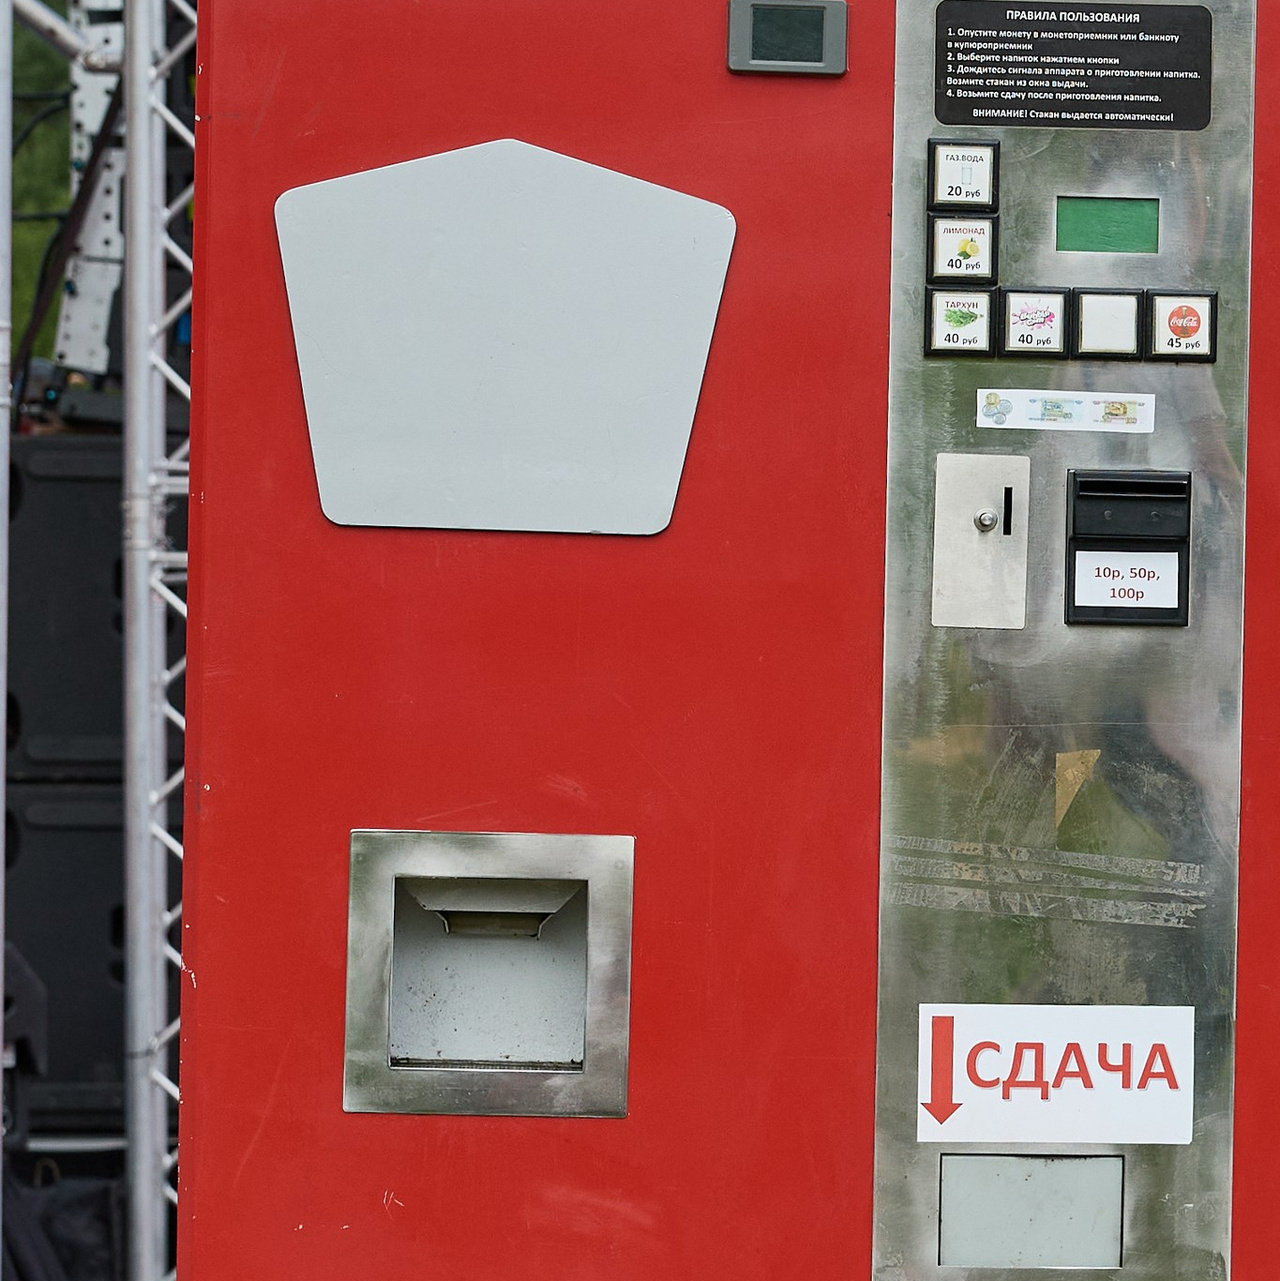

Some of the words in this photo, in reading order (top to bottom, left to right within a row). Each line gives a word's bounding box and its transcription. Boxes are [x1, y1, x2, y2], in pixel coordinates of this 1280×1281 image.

[1006, 10, 1057, 21] ПРАВИЛА
[1060, 11, 1140, 23] ПОЛЬЗОВАНИЯ
[947, 27, 956, 37] 1.
[957, 28, 998, 39] Опустите
[998, 31, 1032, 40] монету
[1040, 32, 1119, 41] монетоприемник
[1138, 32, 1180, 43] банкноту
[954, 42, 1033, 51] купюроприемник
[946, 52, 955, 61] 2.
[957, 52, 1001, 63] Выберите
[1002, 54, 1039, 63] напиток
[1040, 56, 1086, 64] нажатием
[1086, 56, 1120, 65] кнопки
[946, 65, 955, 73] 3.
[956, 64, 1007, 75] Дождитесь
[1008, 67, 1043, 75] сигнала
[1044, 68, 1085, 77] аппарата
[1094, 69, 1161, 78] приготовлении
[1163, 70, 1201, 79] напитка.
[946, 76, 985, 86] Возмите
[1051, 81, 1089, 89] выдачи.
[946, 89, 955, 97] 4.
[956, 89, 999, 99] Возьмите
[1000, 91, 1027, 101] сдачу
[1055, 92, 1122, 101] приготовления
[1123, 93, 1162, 102] напитка.
[972, 108, 1028, 118] ВНИМАНИЕ!
[1029, 109, 1060, 118] Стакан
[1061, 111, 1103, 120] выдается
[1104, 112, 1174, 121] автоматически!
[945, 154, 984, 163] ГАЗ.ВОДА
[947, 185, 962, 196] 20
[965, 189, 981, 199] руб
[942, 227, 986, 236] ЛИМОНАД
[947, 258, 962, 269] 40
[965, 261, 981, 271] руб
[945, 301, 979, 309] ТАРХУН
[944, 333, 960, 344] 40
[962, 336, 978, 345] руб
[1018, 334, 1033, 344] 40
[1036, 336, 1052, 346] руб
[1167, 337, 1182, 348] 45
[1185, 340, 1201, 350] руб
[1094, 566, 1125, 581] 10р,
[1129, 567, 1161, 581] 50р,
[1110, 587, 1145, 601] 100р
[965, 1040, 1179, 1102] СДАЧА
